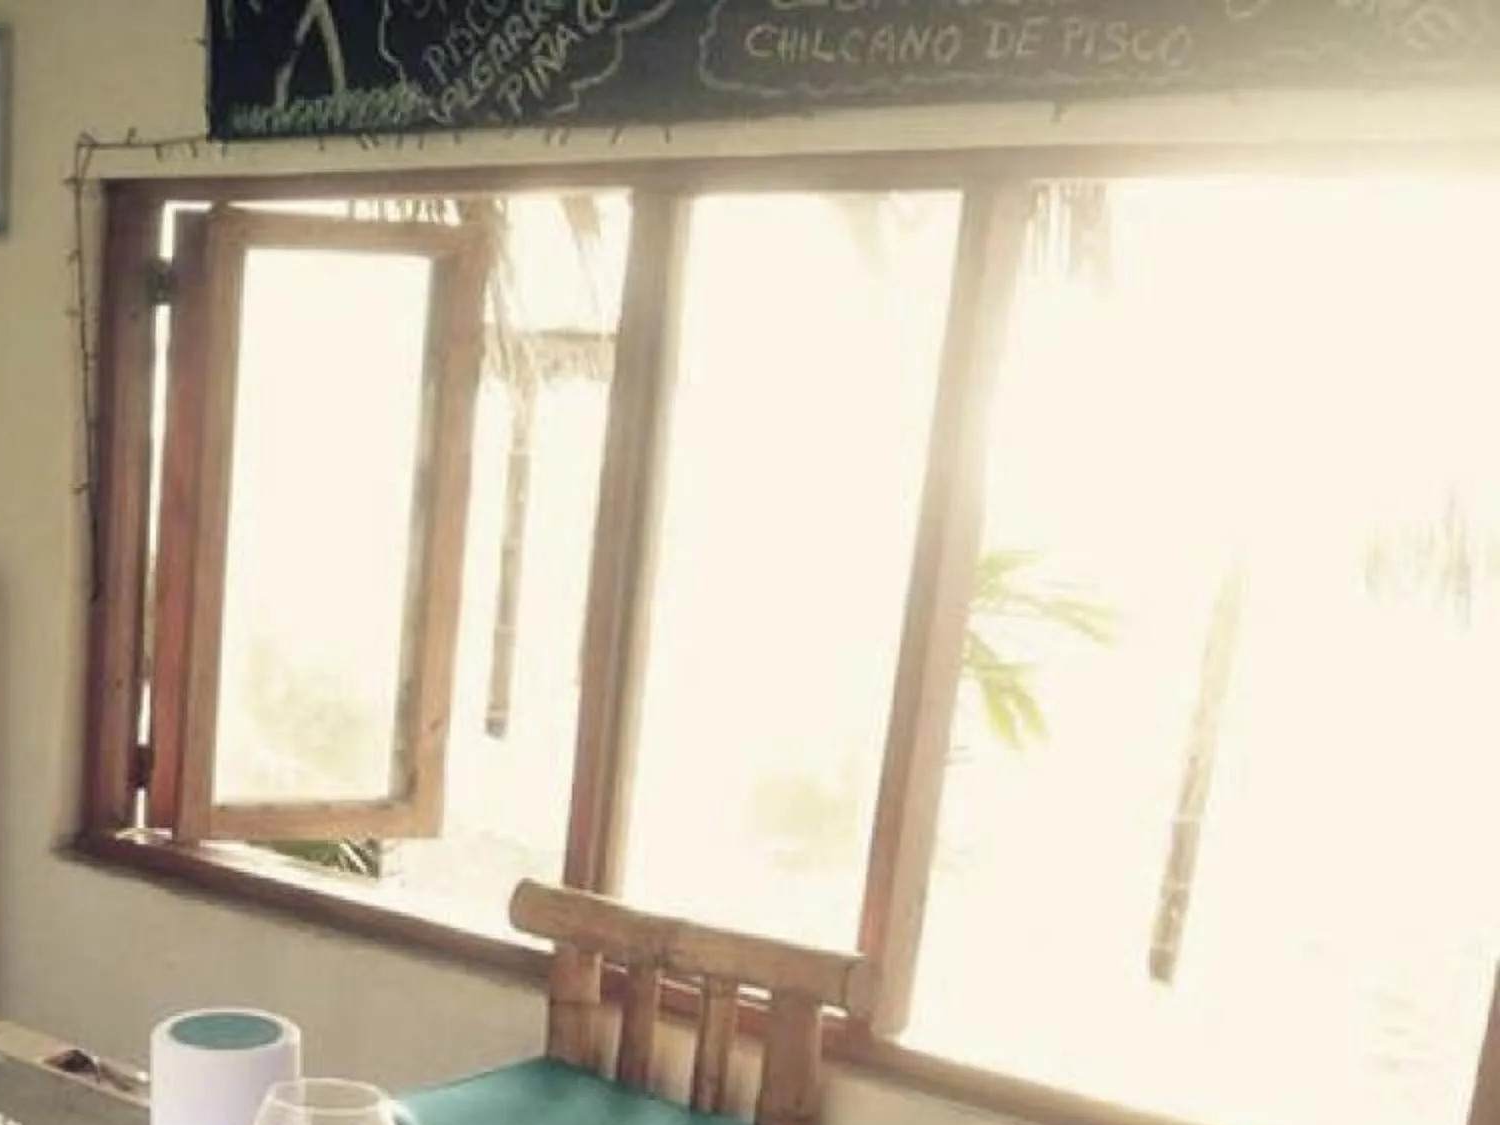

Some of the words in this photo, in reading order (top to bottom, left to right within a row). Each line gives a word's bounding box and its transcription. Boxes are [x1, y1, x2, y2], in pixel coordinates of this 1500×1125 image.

[744, 22, 962, 64] CHILCANO
[984, 16, 1047, 59] DE
[1062, 17, 1193, 67] PISCO
